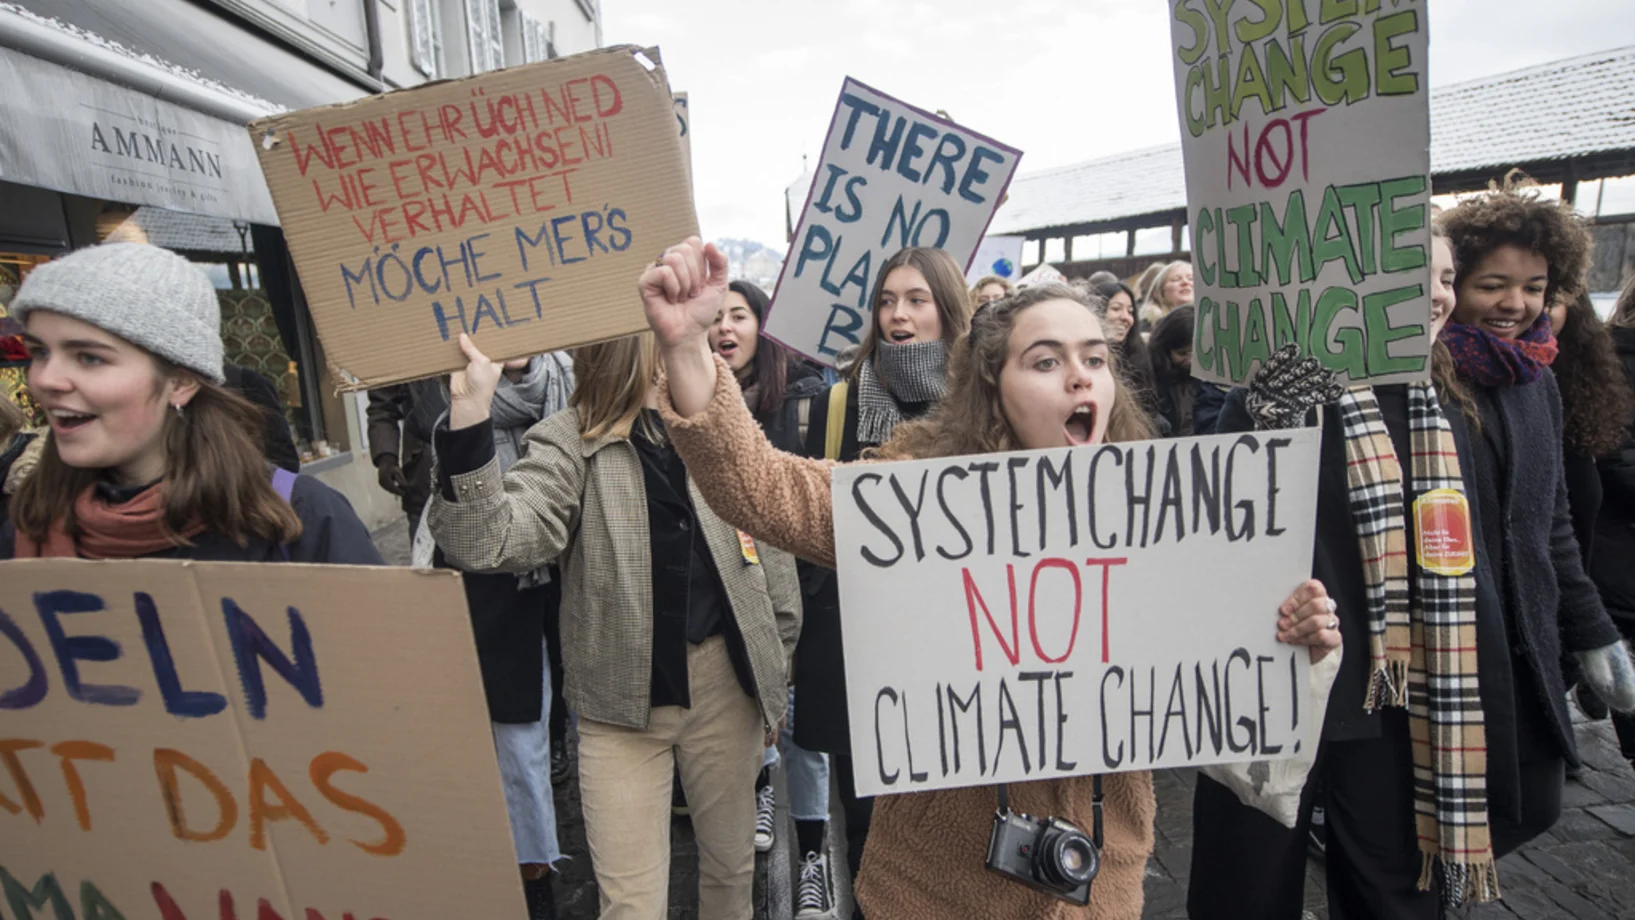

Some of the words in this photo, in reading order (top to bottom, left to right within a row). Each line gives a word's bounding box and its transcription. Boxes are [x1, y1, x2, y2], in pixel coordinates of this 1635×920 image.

[1184, 9, 1419, 137] CHANGE
[91, 121, 222, 179] AMMANN
[287, 117, 396, 177] WENN
[397, 104, 469, 153] EHR
[470, 86, 539, 139] ÜCH
[541, 75, 623, 128] NED
[842, 93, 1005, 204] THERE
[1227, 107, 1327, 191] NOT
[312, 168, 387, 212] WIE
[352, 168, 580, 244] VERHALTET
[813, 163, 867, 223] IS
[881, 193, 950, 250] NO
[1195, 175, 1427, 289] CLIMATE
[339, 232, 501, 308] MÖCHE
[432, 277, 551, 341] HALT
[816, 303, 864, 356] B
[1196, 283, 1428, 382] CHANGE
[961, 556, 1128, 671] NOT
[874, 670, 1077, 785] CLIMATE
[1099, 647, 1302, 770] CHANGE!
[153, 747, 407, 857] DAS
